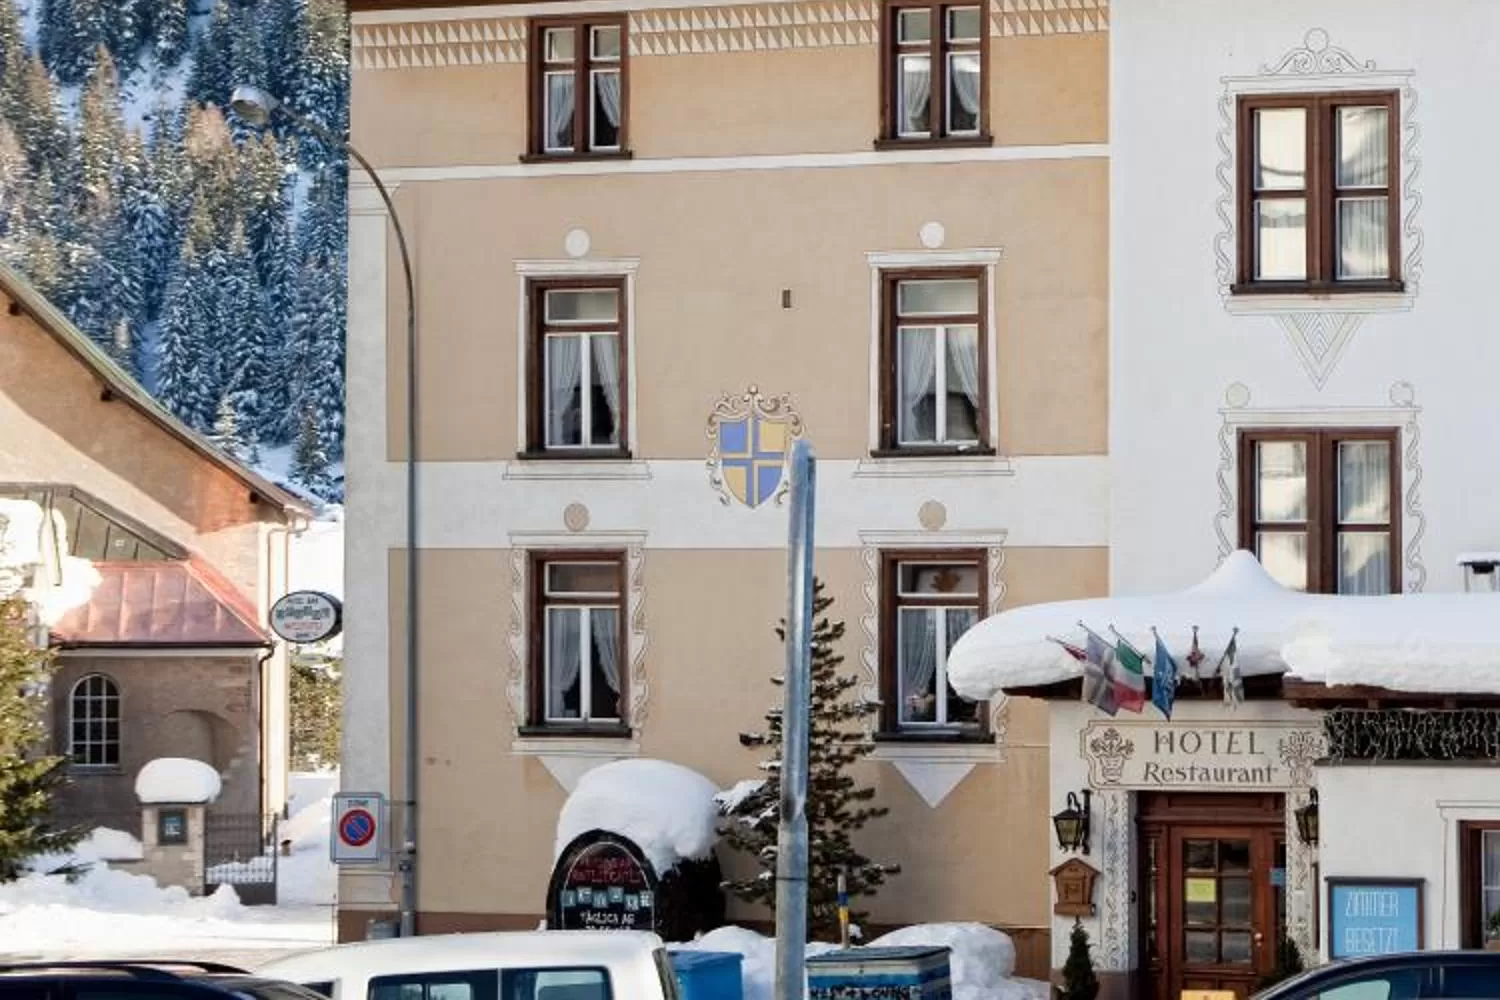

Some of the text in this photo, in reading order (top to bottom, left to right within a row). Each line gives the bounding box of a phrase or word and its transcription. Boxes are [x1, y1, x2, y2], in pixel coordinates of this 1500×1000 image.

[1153, 730, 1265, 756] HOTEL
[1143, 761, 1279, 786] Restaurant
[1345, 891, 1399, 917] ZIMMER
